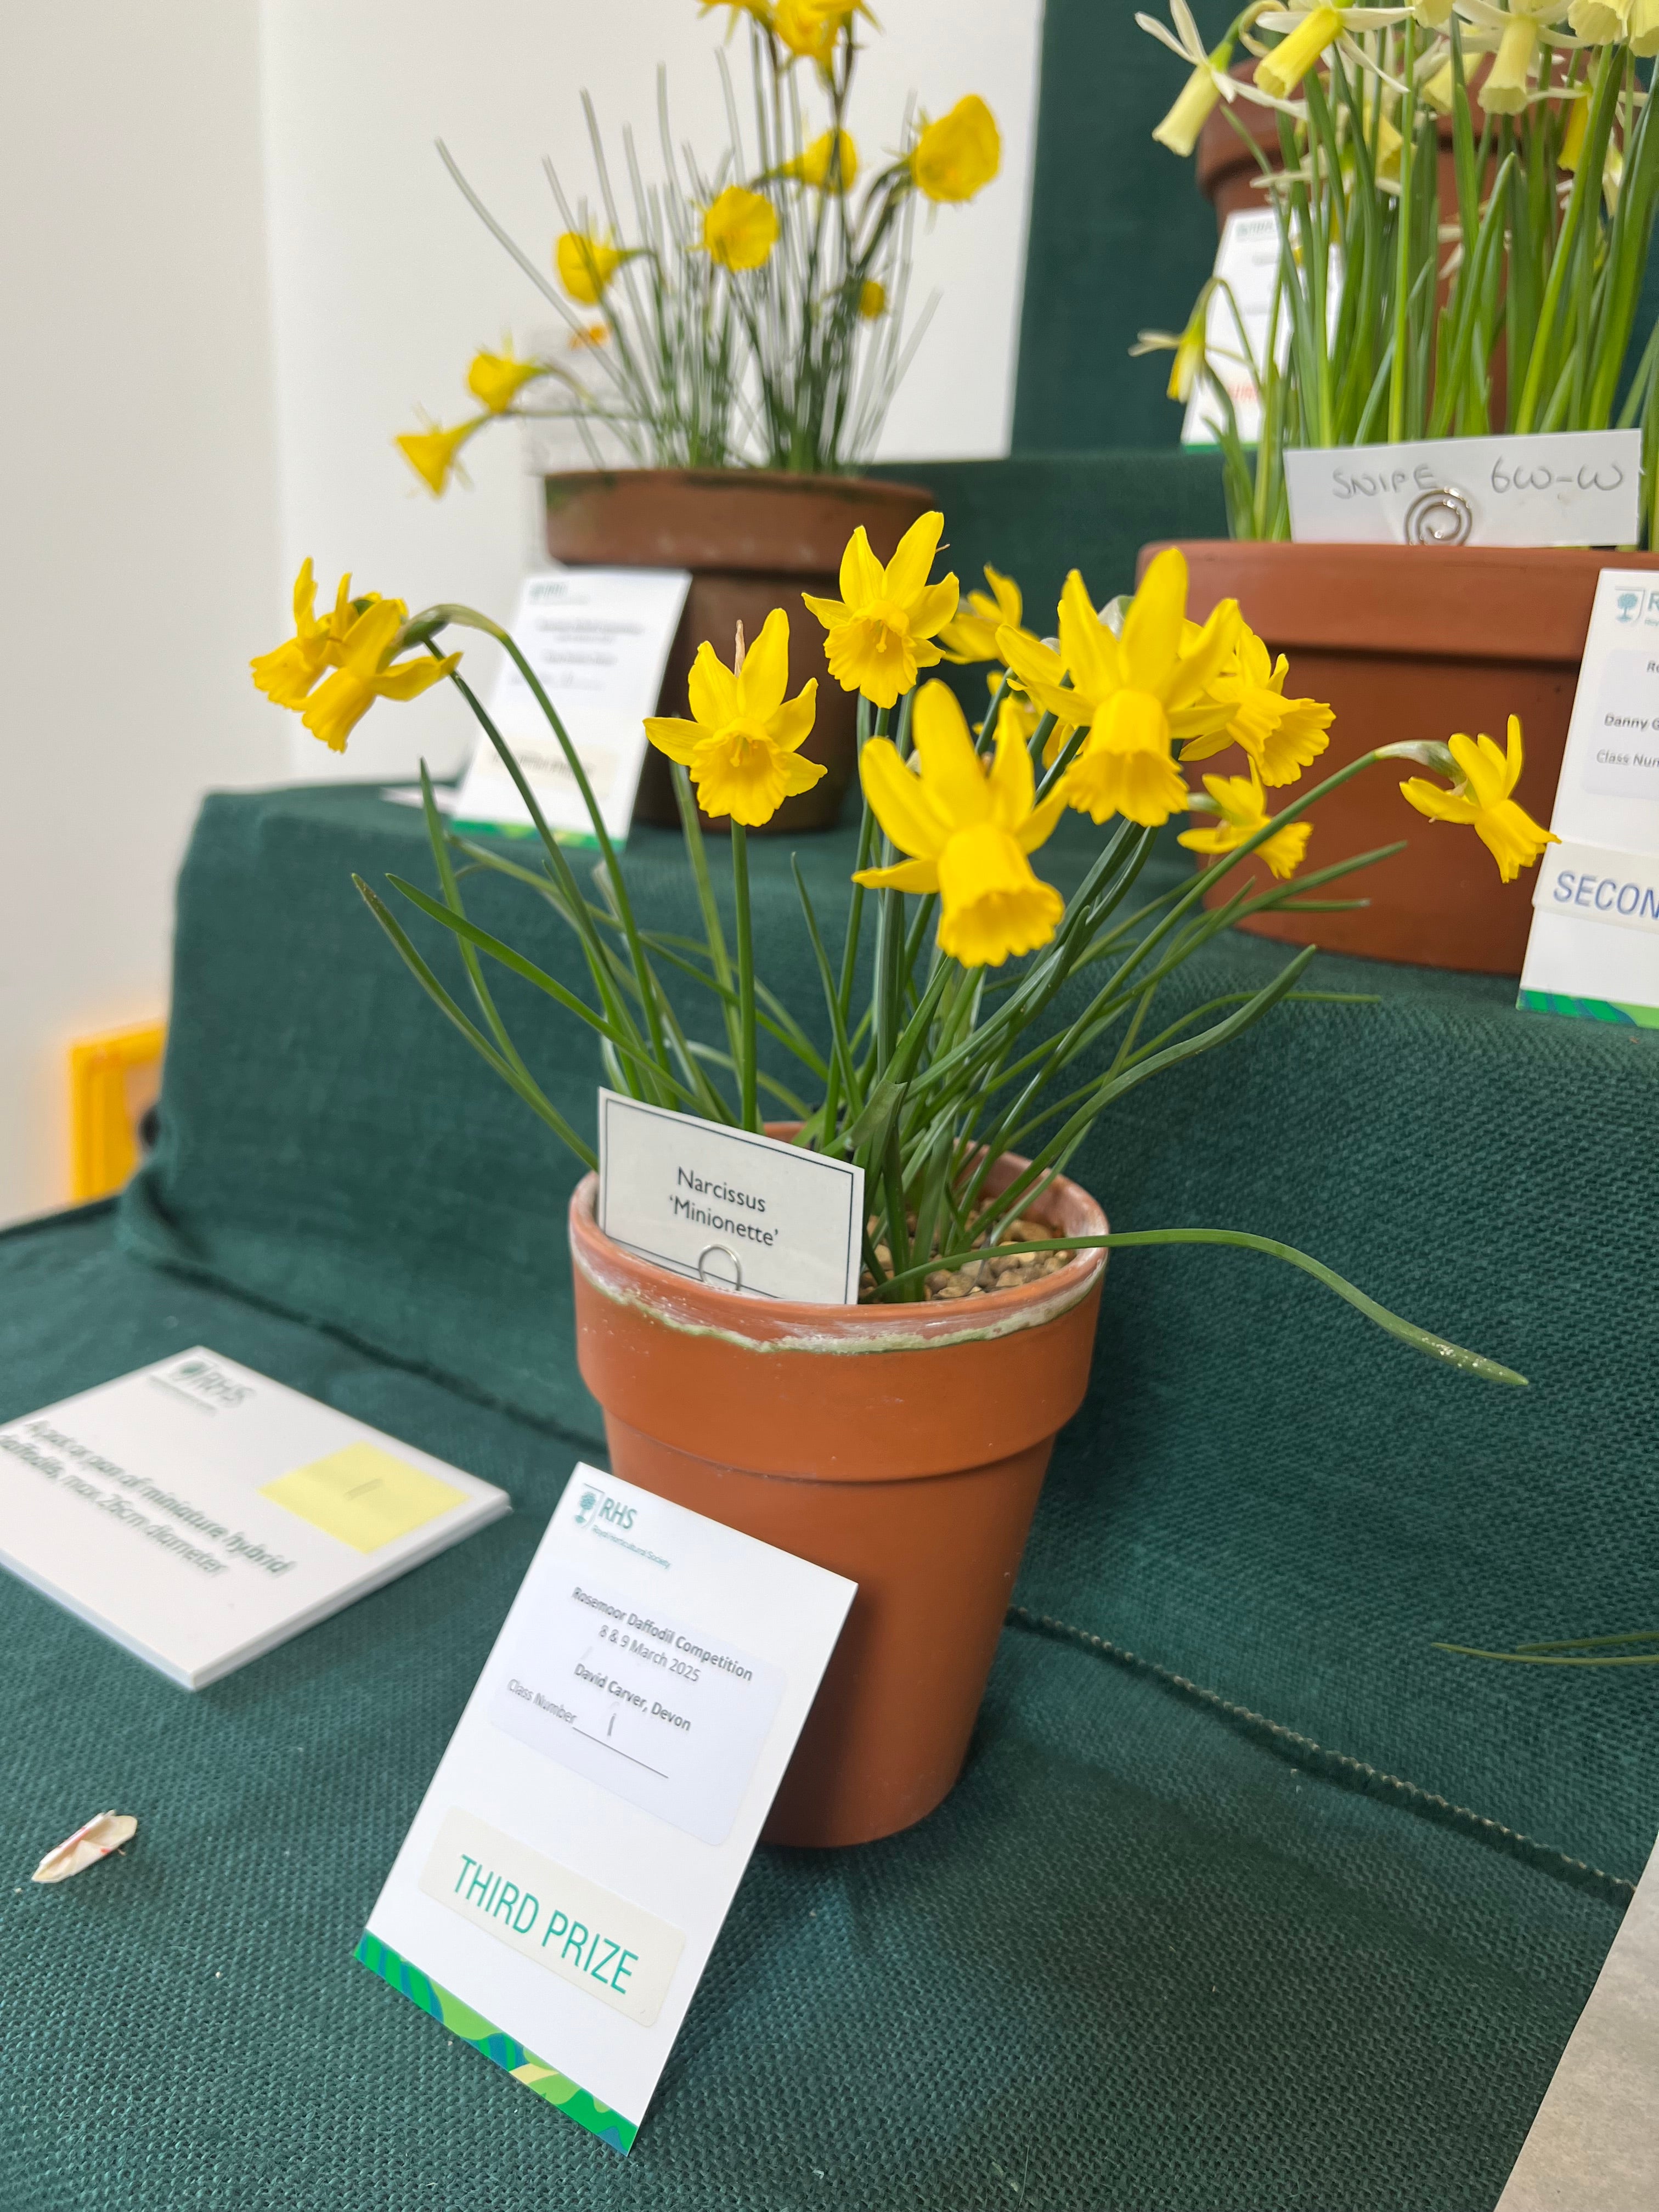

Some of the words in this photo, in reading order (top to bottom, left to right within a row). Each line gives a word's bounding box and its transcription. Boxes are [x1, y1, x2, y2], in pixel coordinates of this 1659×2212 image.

[1331, 463, 1437, 499] SNIPE
[1604, 712, 1649, 731] Danny
[1596, 749, 1630, 765] Class
[677, 1166, 767, 1213] Narcissus
[139, 1485, 228, 1538] miniature
[222, 1531, 296, 1576] hybrid
[598, 1497, 638, 1530] RHS
[144, 1523, 228, 1575] diameter
[571, 1586, 627, 1622] Rosemoor
[627, 1612, 676, 1645] Daffodil
[675, 1635, 754, 1682] Competition
[598, 1624, 608, 1638] 8
[608, 1629, 619, 1643] &
[620, 1635, 630, 1648] 9
[629, 1639, 668, 1668] March
[668, 1658, 701, 1683] 2025
[507, 1678, 534, 1701] Class
[533, 1692, 578, 1725] Number
[574, 1663, 607, 1690] David
[607, 1680, 648, 1713] Carver,
[651, 1701, 691, 1731] Devon
[455, 1853, 540, 1934] THIRD
[541, 1909, 639, 1995] PRIZE
